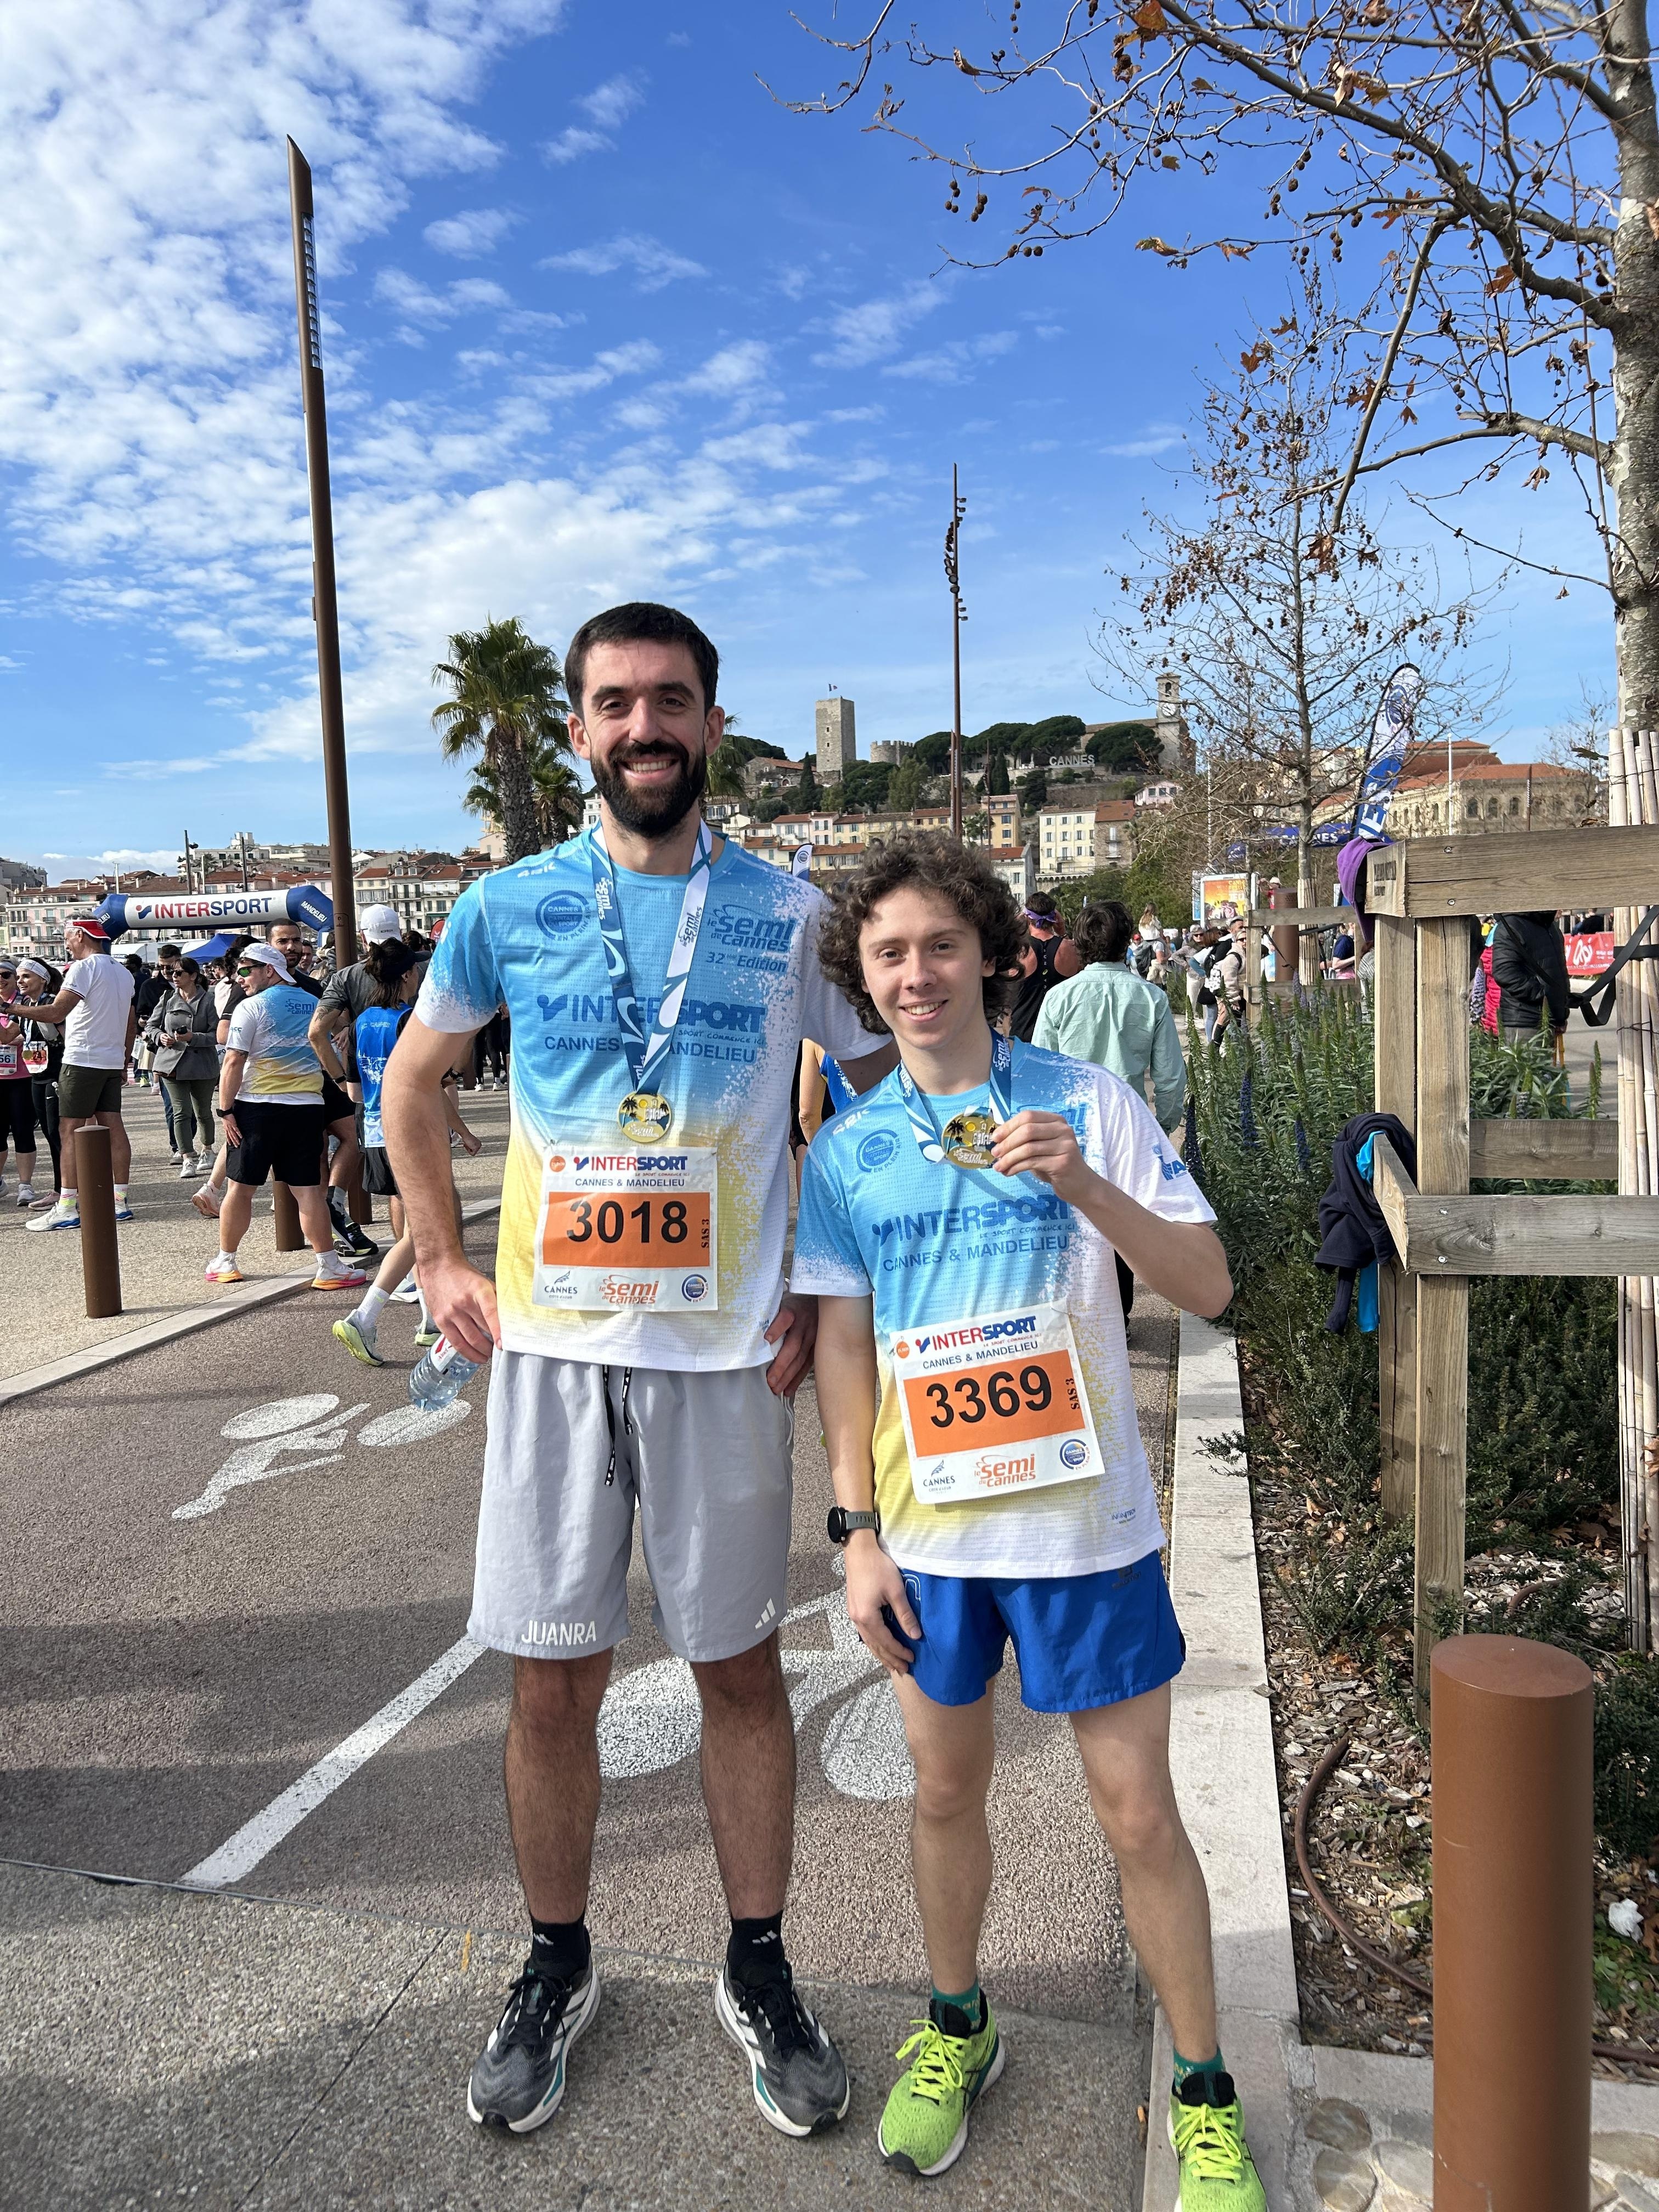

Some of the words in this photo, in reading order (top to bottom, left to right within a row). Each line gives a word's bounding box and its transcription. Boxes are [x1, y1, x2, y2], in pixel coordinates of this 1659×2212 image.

[155, 897, 271, 919] INTERSPORT
[301, 900, 328, 922] MANDELIEU
[707, 917, 718, 927] le
[714, 916, 797, 940] semi
[721, 934, 791, 953] cannes
[737, 955, 788, 973] Edition
[678, 1029, 704, 1037] SPORT
[707, 1033, 751, 1043] COMMENCE
[544, 1036, 620, 1052] CANNES
[670, 1041, 756, 1063] ANDELIEU
[591, 1155, 688, 1171] INTERSPORT
[884, 1151, 900, 1169] PLEIN
[575, 1178, 613, 1187] CANNES
[617, 1178, 623, 1187] &
[627, 1178, 685, 1187] MANDELIEU
[567, 1200, 688, 1243] 3018
[701, 1228, 709, 1248] SAS
[883, 1250, 943, 1272] CANNES
[949, 1249, 961, 1261] &
[967, 1235, 1068, 1261] MANDELIEU
[544, 1285, 578, 1294] CANNES
[604, 1280, 659, 1296] semi
[609, 1295, 657, 1305] cannes
[933, 1316, 1036, 1351] INTERSPORT
[923, 1355, 962, 1370] CANNES
[966, 1353, 973, 1362] &
[976, 1341, 1039, 1359] MANDELIEU
[927, 1365, 1052, 1427] 3369
[1067, 1388, 1080, 1410] SAS
[980, 1454, 1035, 1479] semi
[923, 1475, 956, 1487] CANNES
[987, 1470, 1036, 1487] cannes
[521, 1620, 596, 1646] JUANRA
